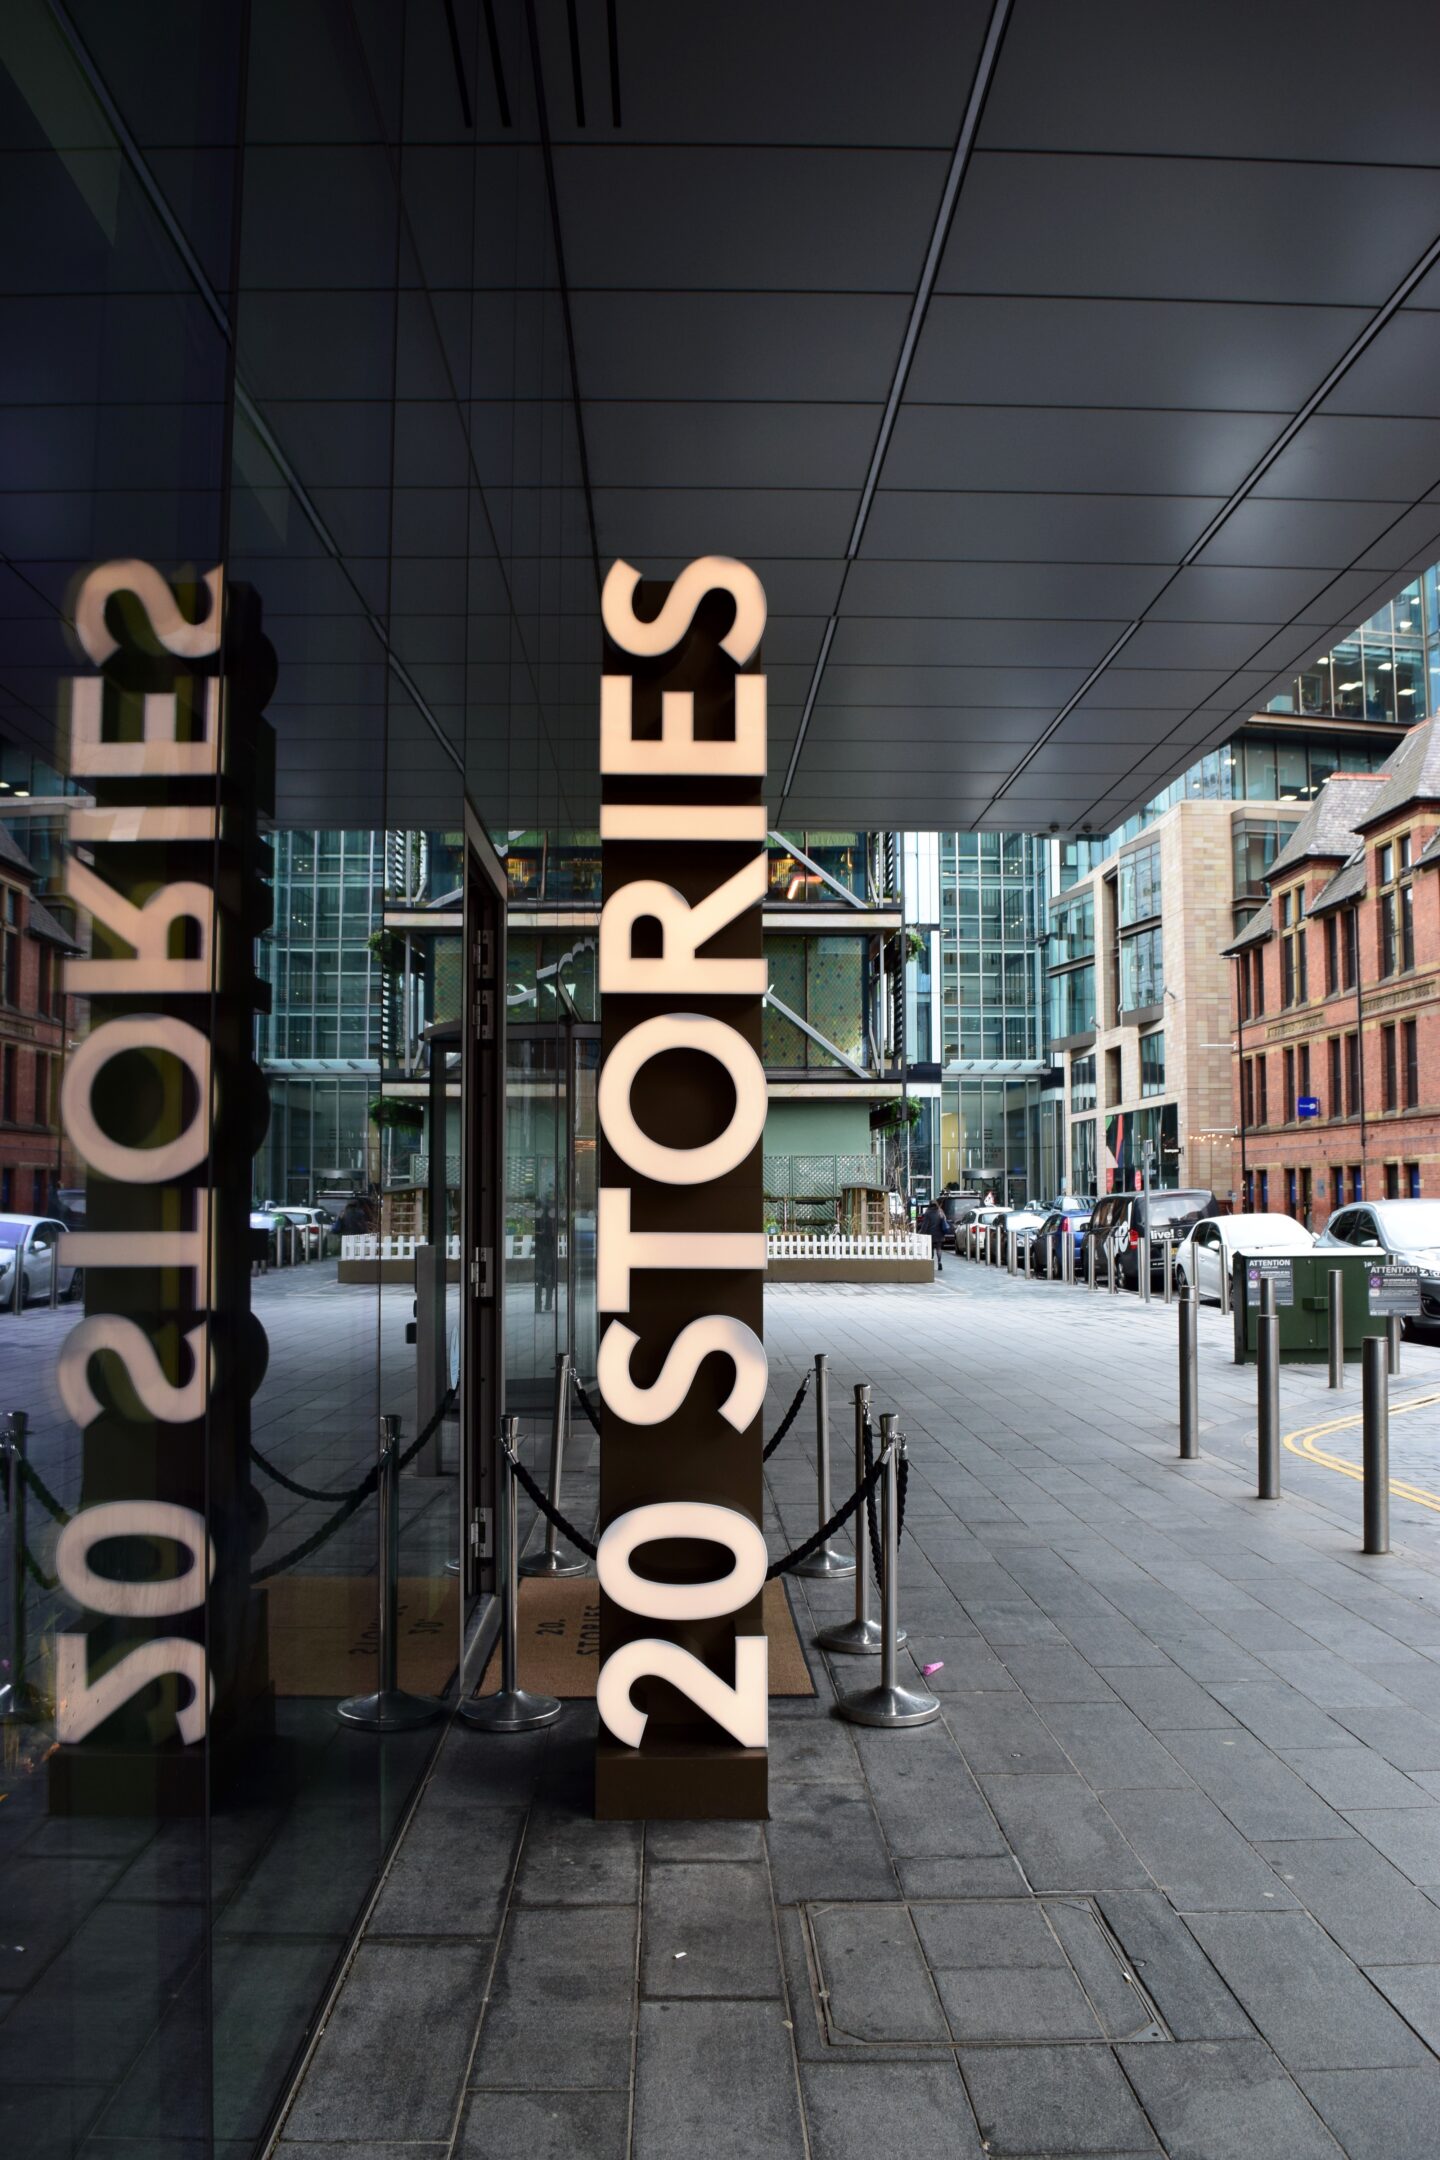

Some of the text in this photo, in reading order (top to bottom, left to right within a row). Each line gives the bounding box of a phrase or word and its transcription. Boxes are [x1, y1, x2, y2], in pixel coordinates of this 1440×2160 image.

[596, 555, 769, 1749] 20 STORIES
[1150, 1228, 1175, 1240] live!
[1249, 1259, 1291, 1267] ATTENTION
[1370, 1265, 1418, 1274] ATTENTION
